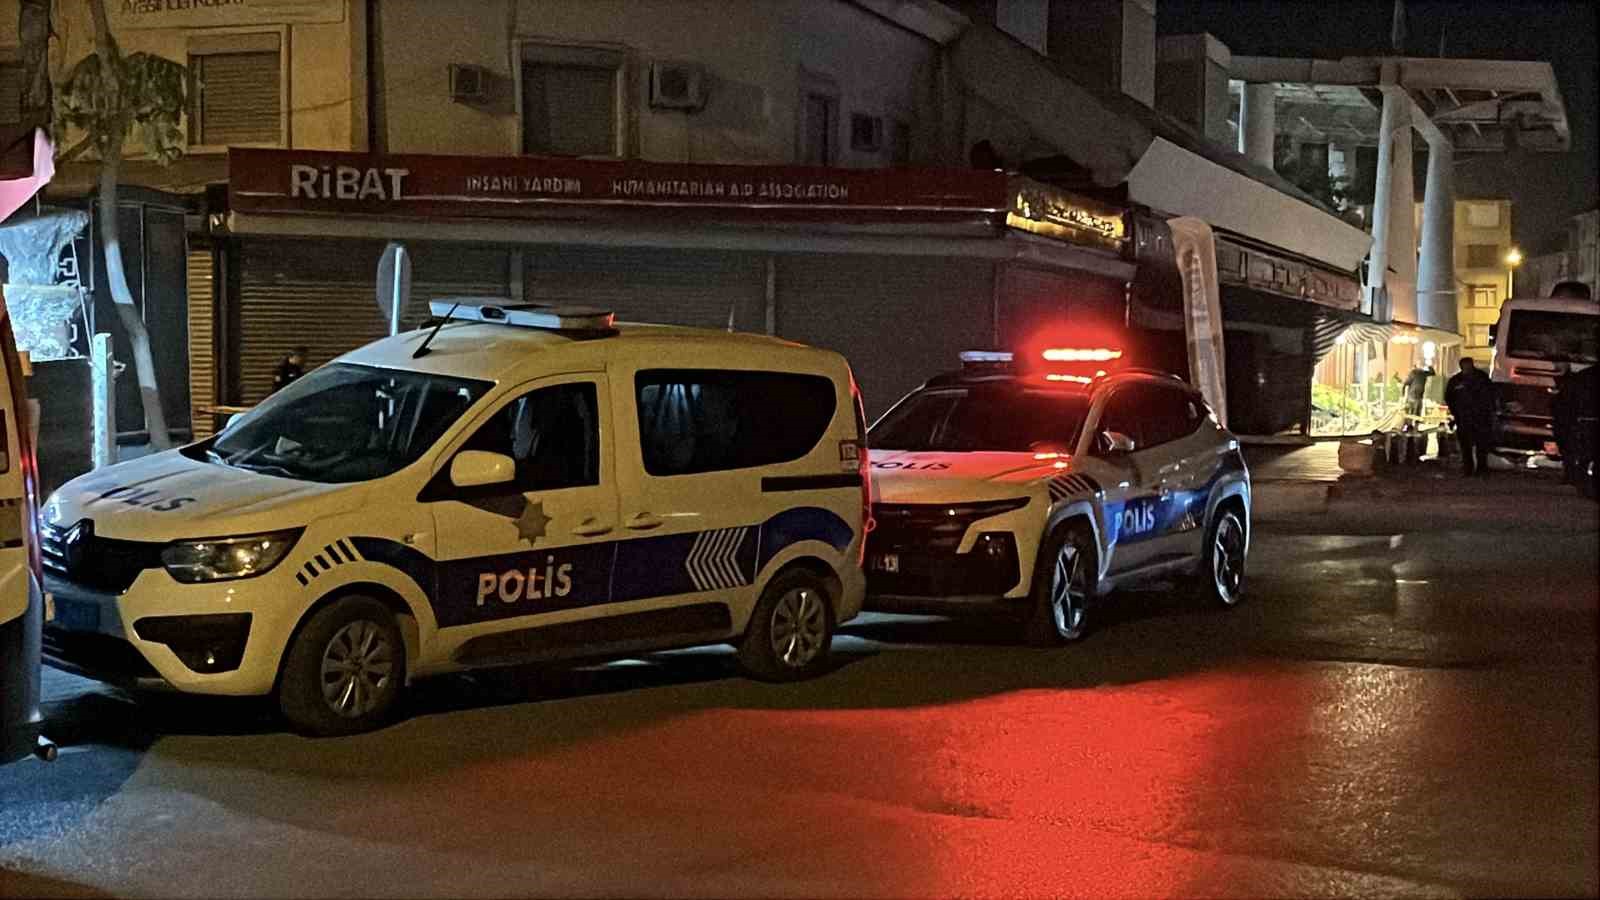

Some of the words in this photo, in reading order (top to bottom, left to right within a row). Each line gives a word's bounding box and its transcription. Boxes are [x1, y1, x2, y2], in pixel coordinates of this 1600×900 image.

[612, 179, 725, 197] HUMANITARIAN
[729, 182, 753, 198] AID
[759, 182, 849, 199] ASSOCIATION
[476, 554, 573, 607] POLİS
